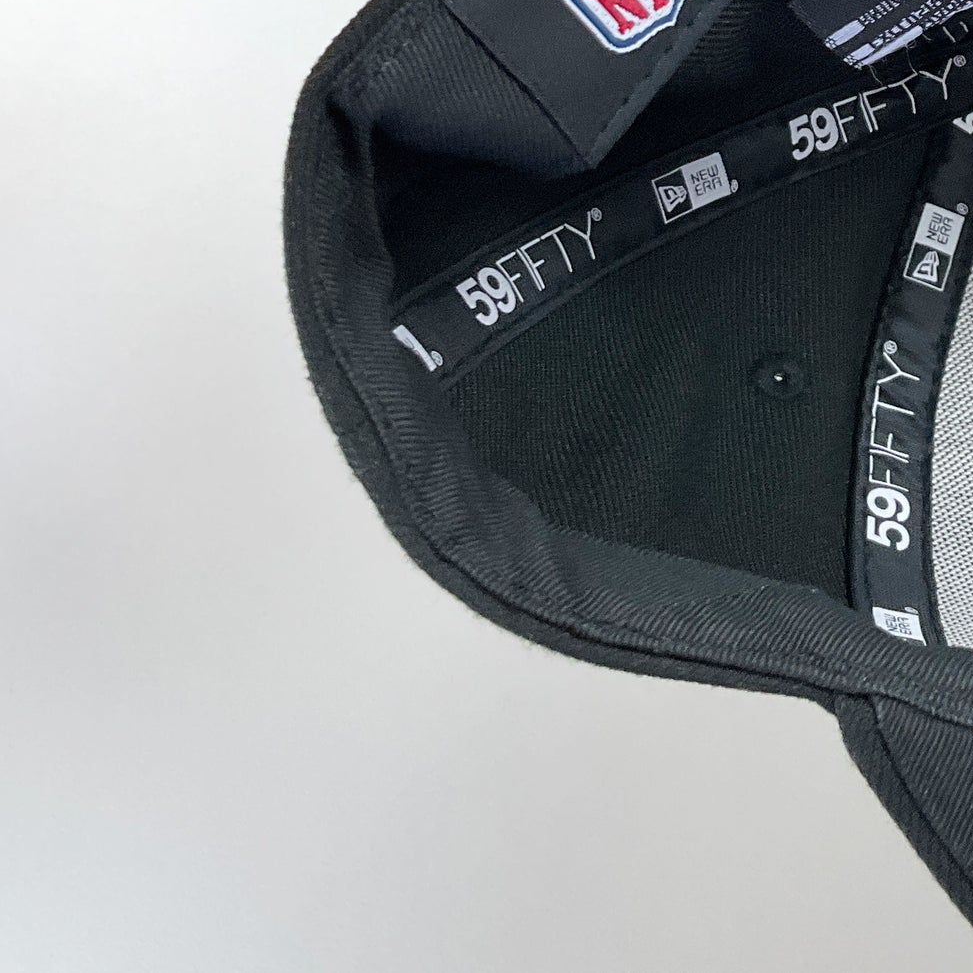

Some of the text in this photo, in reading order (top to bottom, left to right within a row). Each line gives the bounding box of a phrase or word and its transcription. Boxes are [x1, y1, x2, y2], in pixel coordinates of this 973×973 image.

[690, 163, 719, 184] NEW
[695, 176, 723, 196] ERA
[926, 211, 943, 241] NEW
[937, 216, 954, 245] ERA
